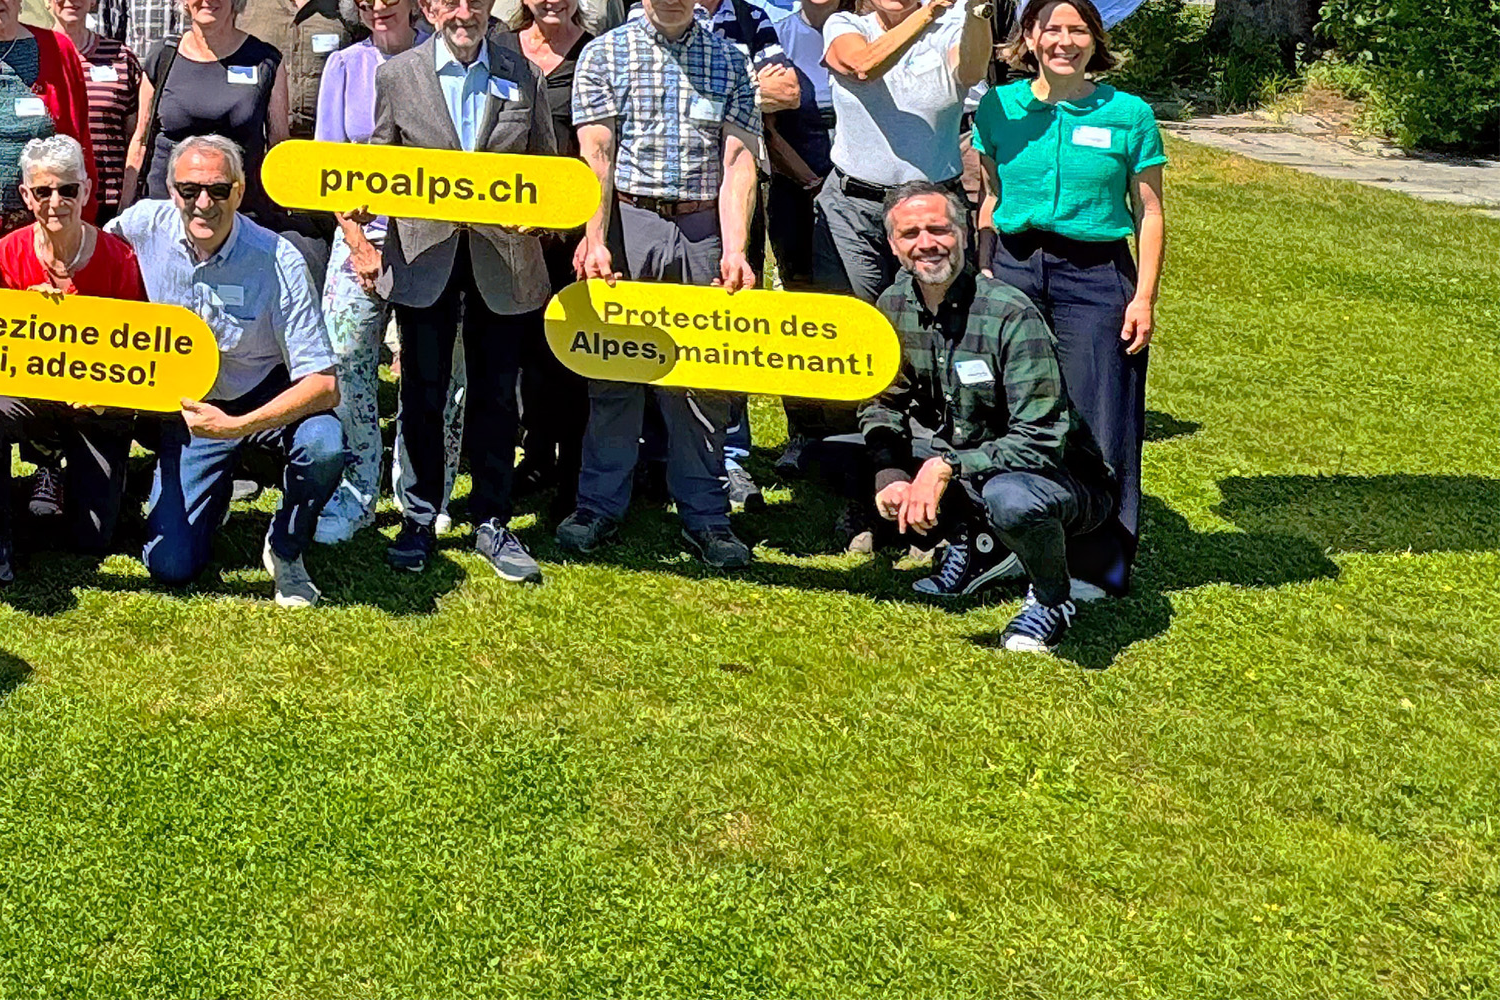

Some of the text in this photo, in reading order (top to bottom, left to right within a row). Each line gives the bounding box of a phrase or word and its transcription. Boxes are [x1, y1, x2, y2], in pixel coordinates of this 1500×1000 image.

[320, 167, 537, 204] proalps.ch
[603, 301, 838, 340] Protection des
[109, 323, 193, 355] delle
[569, 331, 666, 365] Alpes,
[26, 351, 156, 386] adesso!
